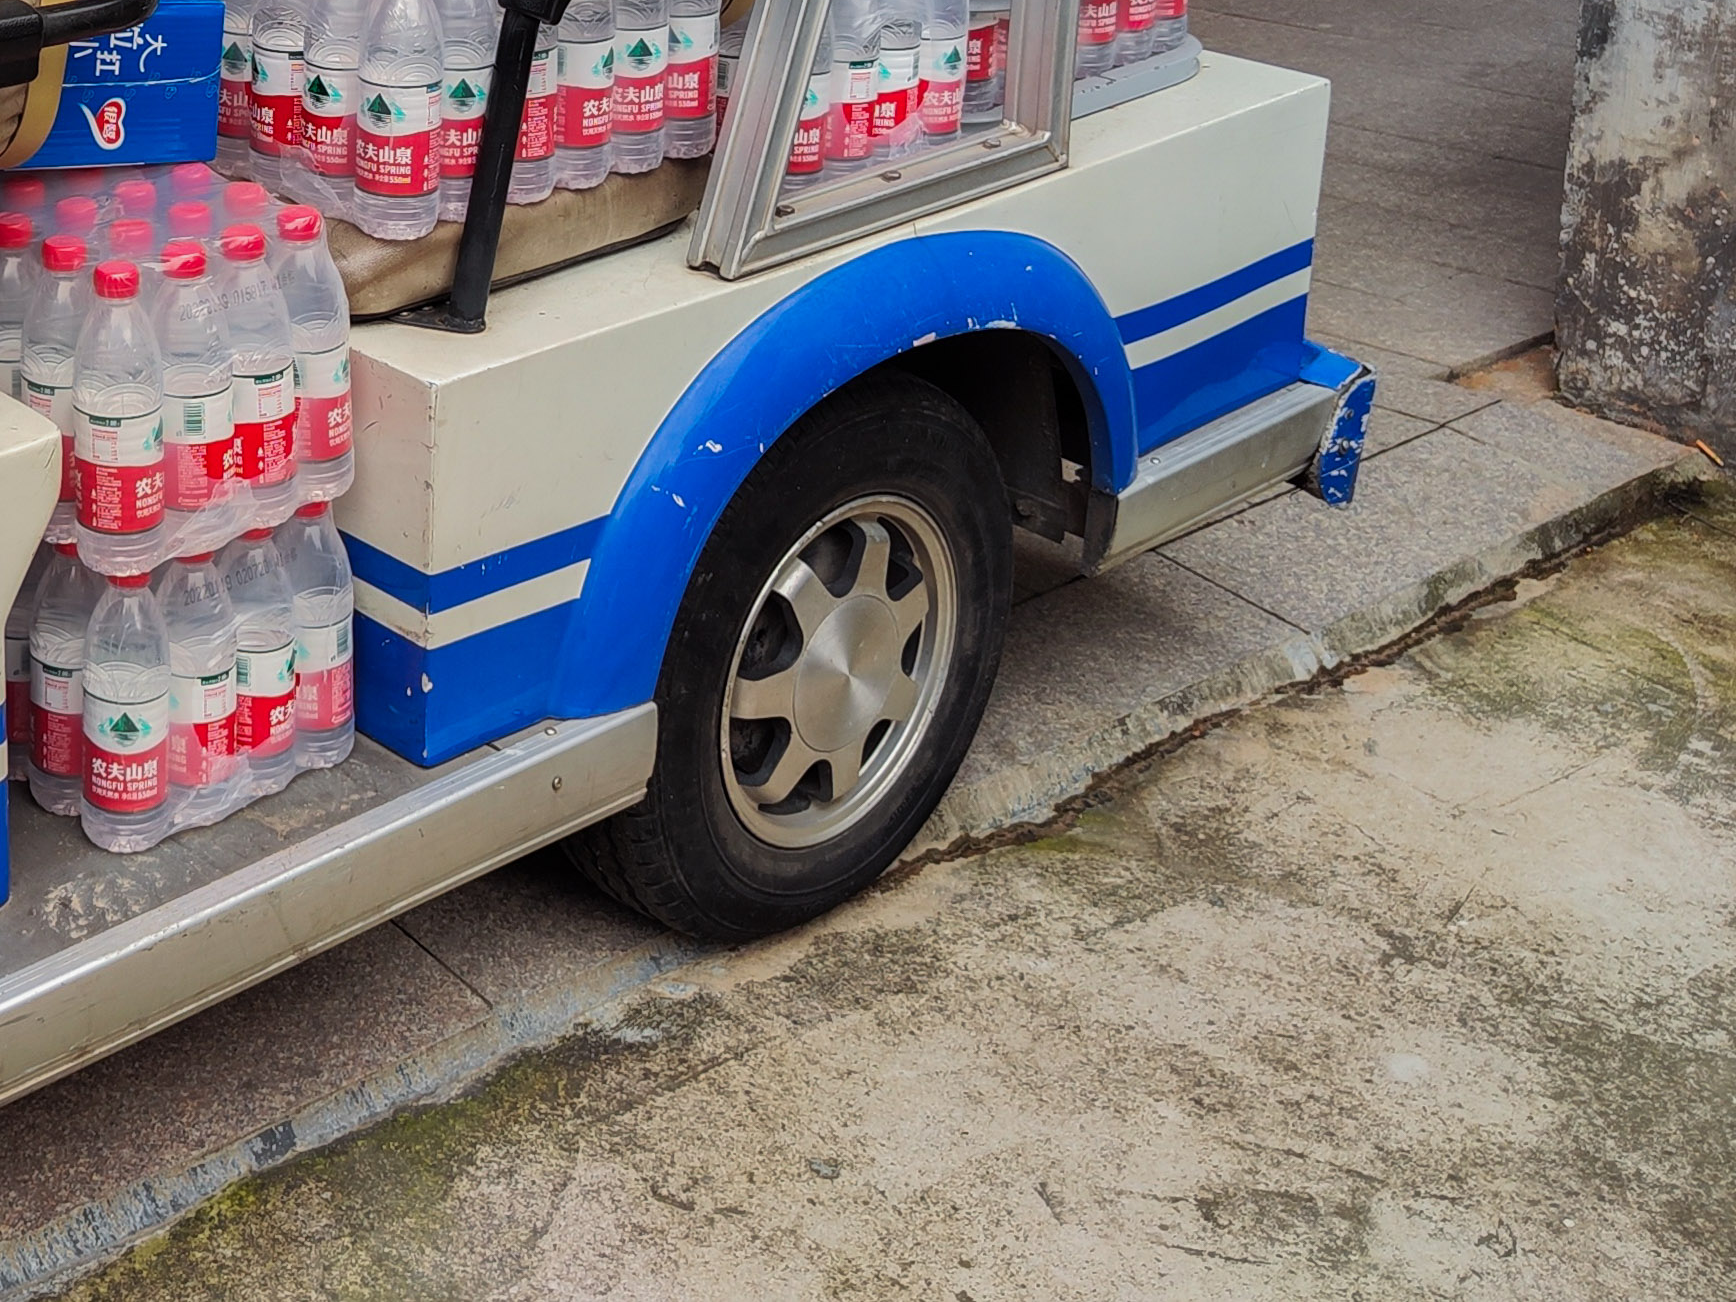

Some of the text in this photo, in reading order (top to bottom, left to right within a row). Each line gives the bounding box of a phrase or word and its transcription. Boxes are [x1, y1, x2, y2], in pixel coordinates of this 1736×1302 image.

[668, 71, 700, 90] 山泉
[379, 164, 412, 175] SPRING
[91, 756, 159, 781] 农夫山泉
[91, 777, 158, 791] NONGFU SPRING
